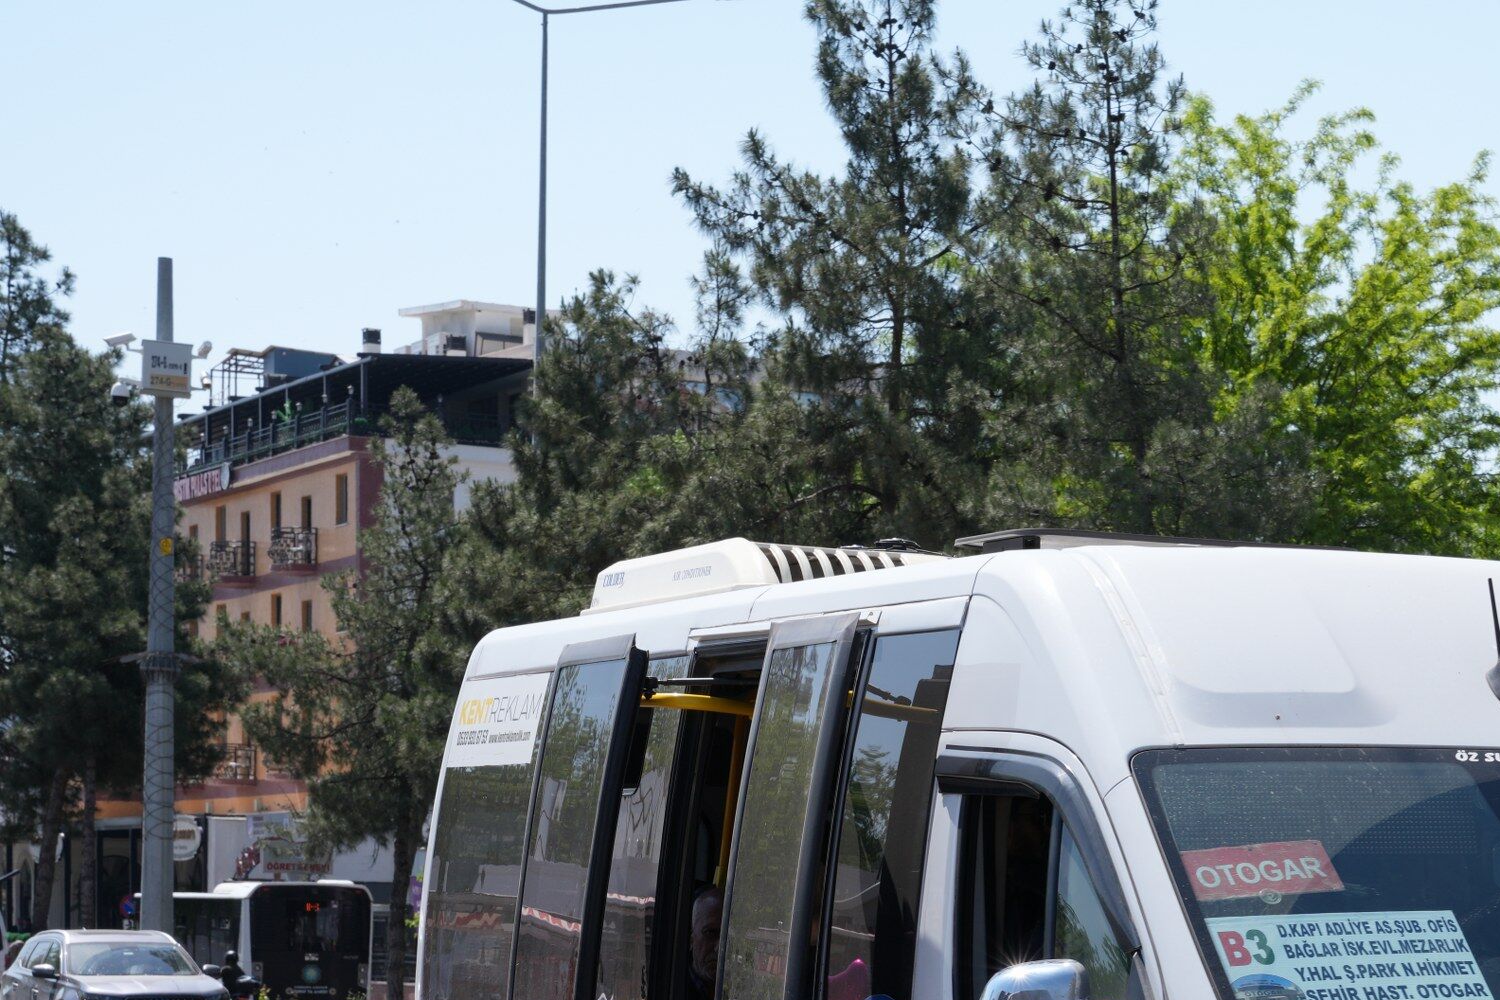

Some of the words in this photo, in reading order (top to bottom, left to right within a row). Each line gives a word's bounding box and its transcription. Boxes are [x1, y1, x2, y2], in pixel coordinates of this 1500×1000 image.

[1455, 750, 1479, 762] ÖZ
[1195, 856, 1327, 888] OTOGAR
[1325, 918, 1372, 937] ADLİYE
[1427, 916, 1458, 933] OFİS
[1217, 929, 1275, 967] B3
[1283, 940, 1340, 959] BAĞLAR
[1294, 966, 1342, 982] Y.HAL
[1343, 962, 1401, 983] Ş.PARK
[1402, 958, 1476, 977] N.HİKMET
[1416, 983, 1488, 999] OTOGAR
